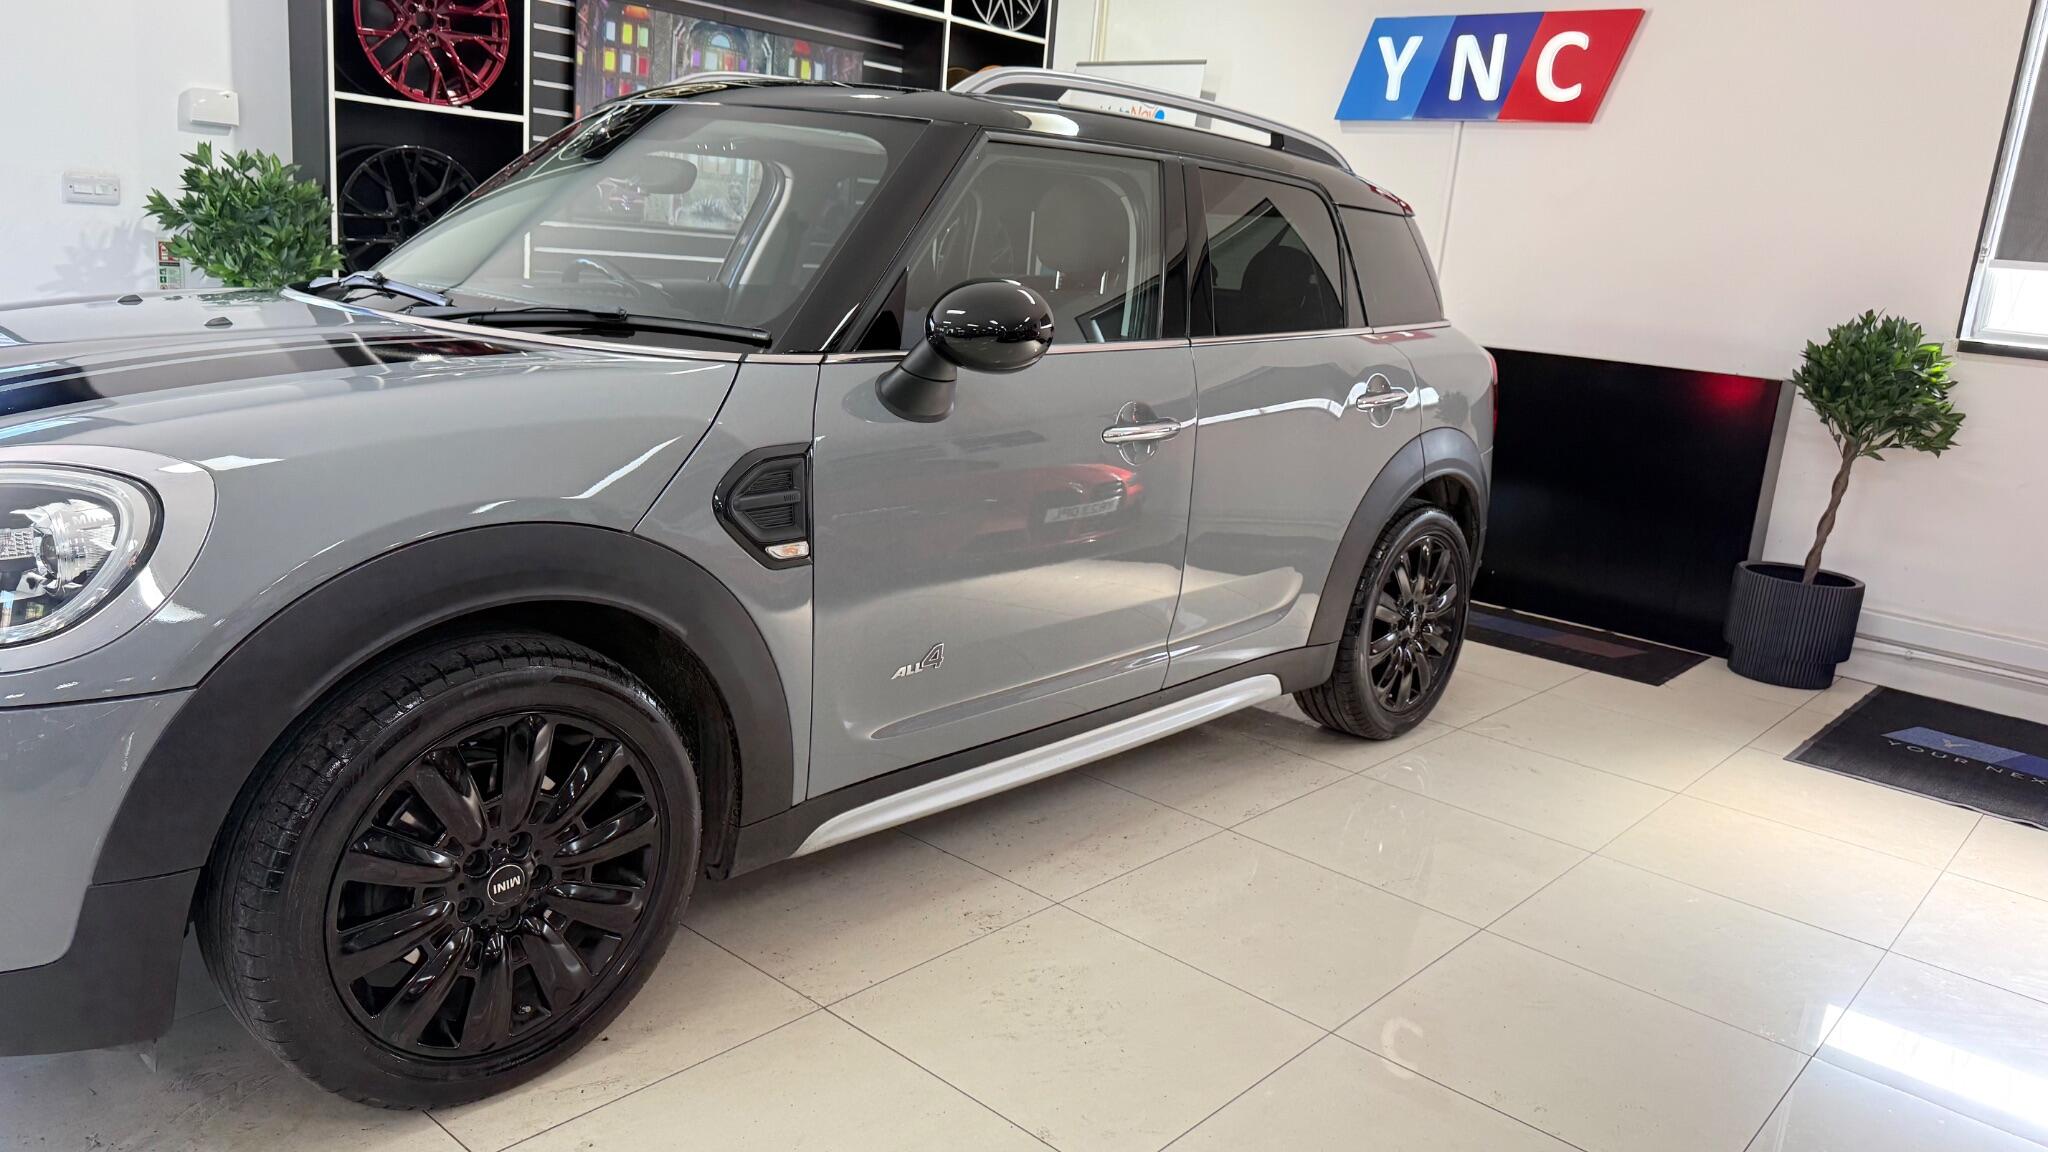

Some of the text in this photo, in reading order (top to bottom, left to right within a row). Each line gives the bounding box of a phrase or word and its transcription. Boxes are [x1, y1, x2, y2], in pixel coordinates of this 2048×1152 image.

[1378, 31, 1589, 102] YNC
[1888, 739, 1968, 763] YOUR
[493, 875, 521, 895] MINI
